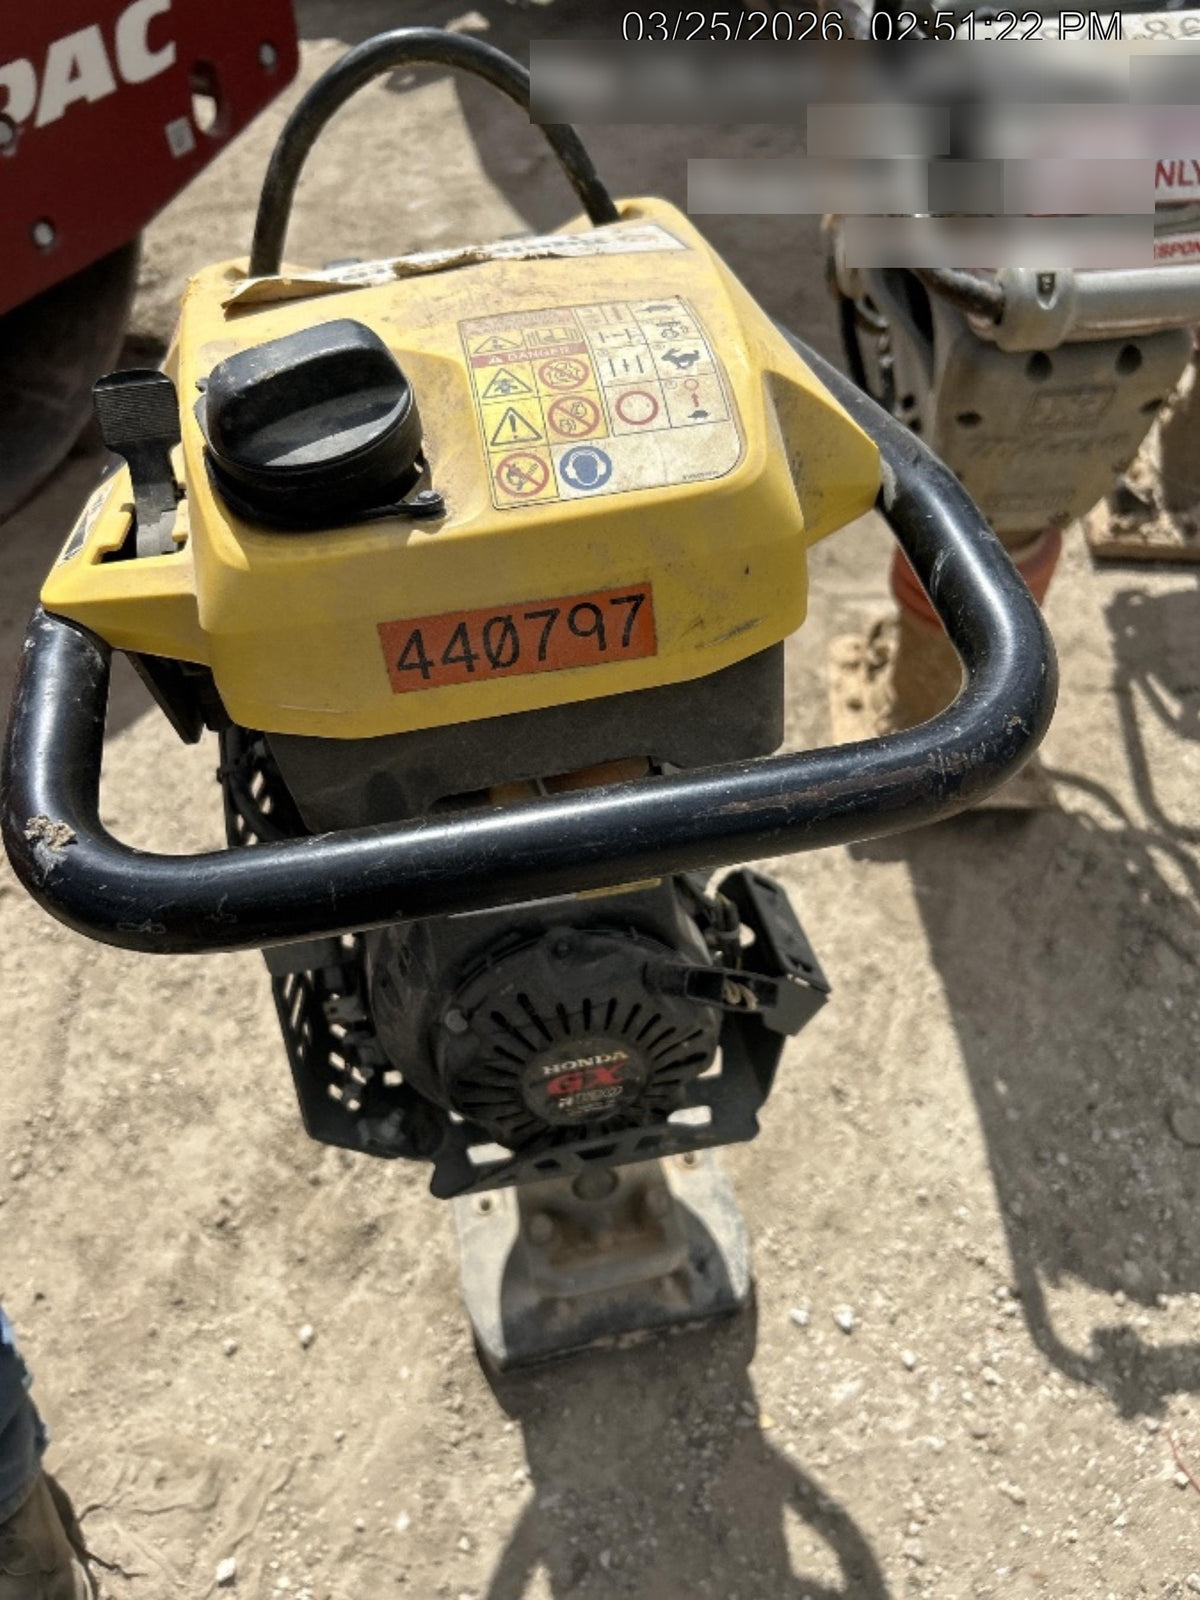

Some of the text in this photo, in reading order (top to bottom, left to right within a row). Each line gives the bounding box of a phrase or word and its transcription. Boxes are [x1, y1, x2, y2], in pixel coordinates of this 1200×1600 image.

[507, 345, 570, 362] DANGER
[396, 592, 646, 680] 440797
[543, 1051, 628, 1075] HONDA
[547, 1061, 626, 1095] GX
